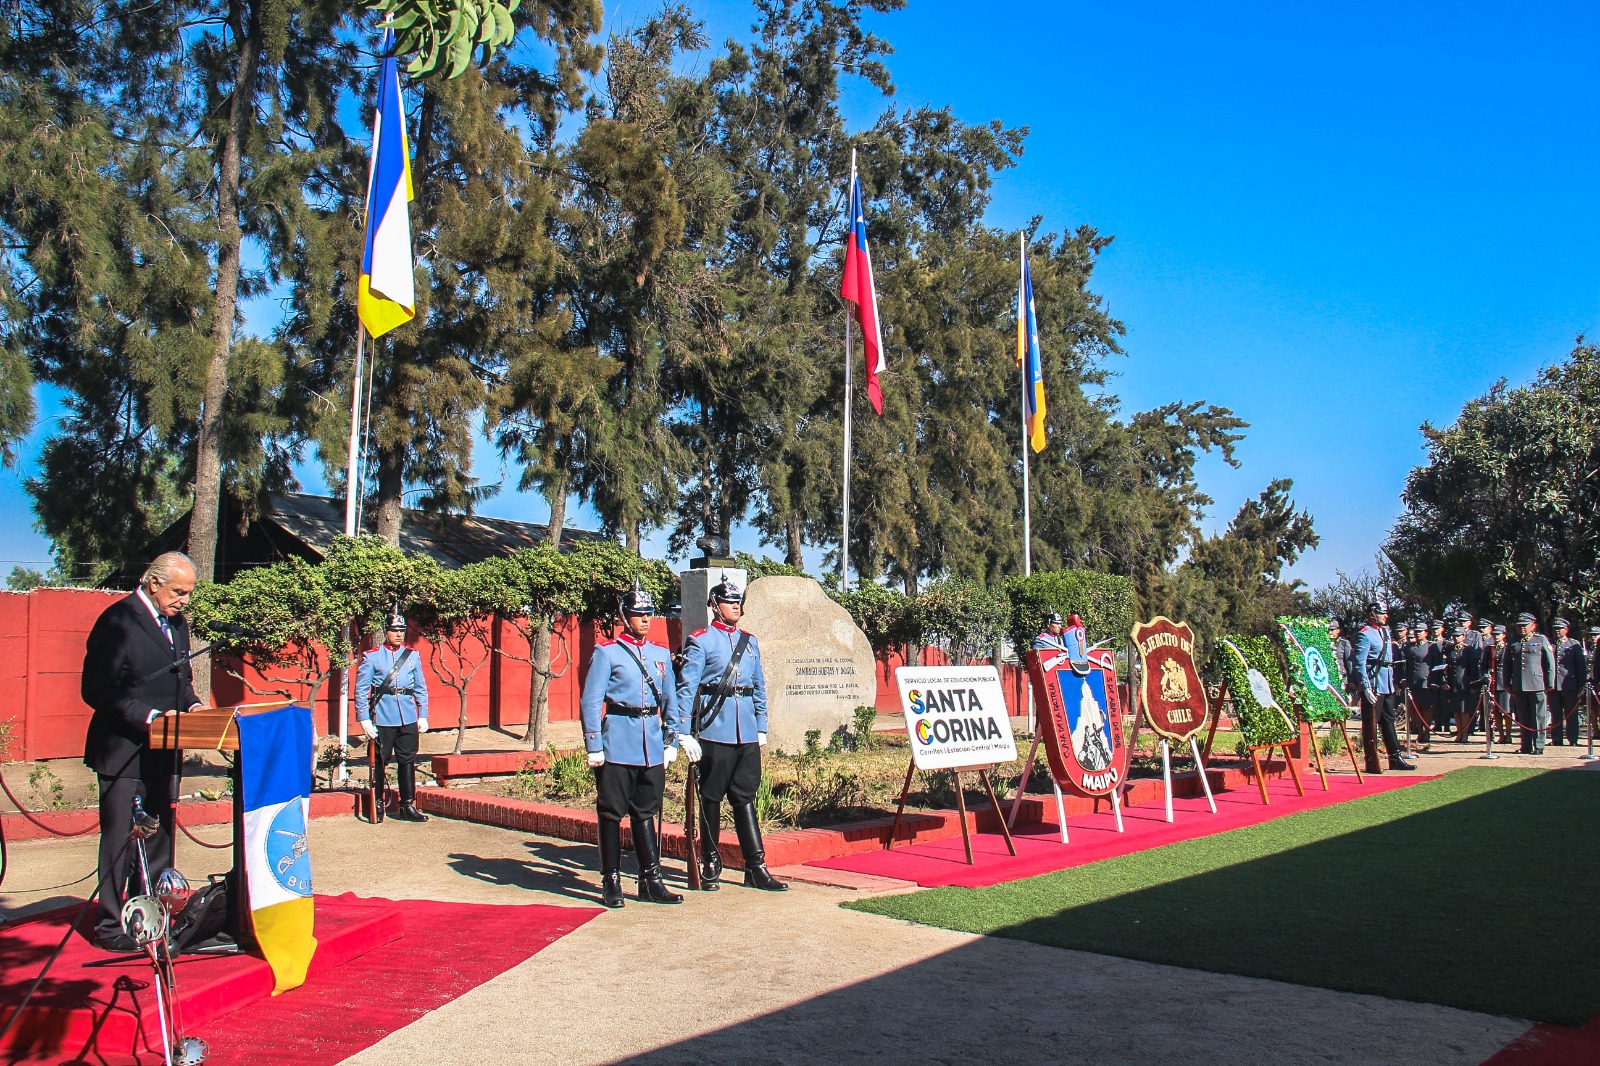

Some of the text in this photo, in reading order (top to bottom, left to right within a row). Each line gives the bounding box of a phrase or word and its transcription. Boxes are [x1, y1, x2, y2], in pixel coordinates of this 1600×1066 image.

[904, 677, 927, 685] SERVICIO
[908, 688, 983, 715] SANTA
[1048, 681, 1060, 711] PATRIA
[1167, 708, 1193, 724] CHILE
[915, 716, 1003, 746] CORINA
